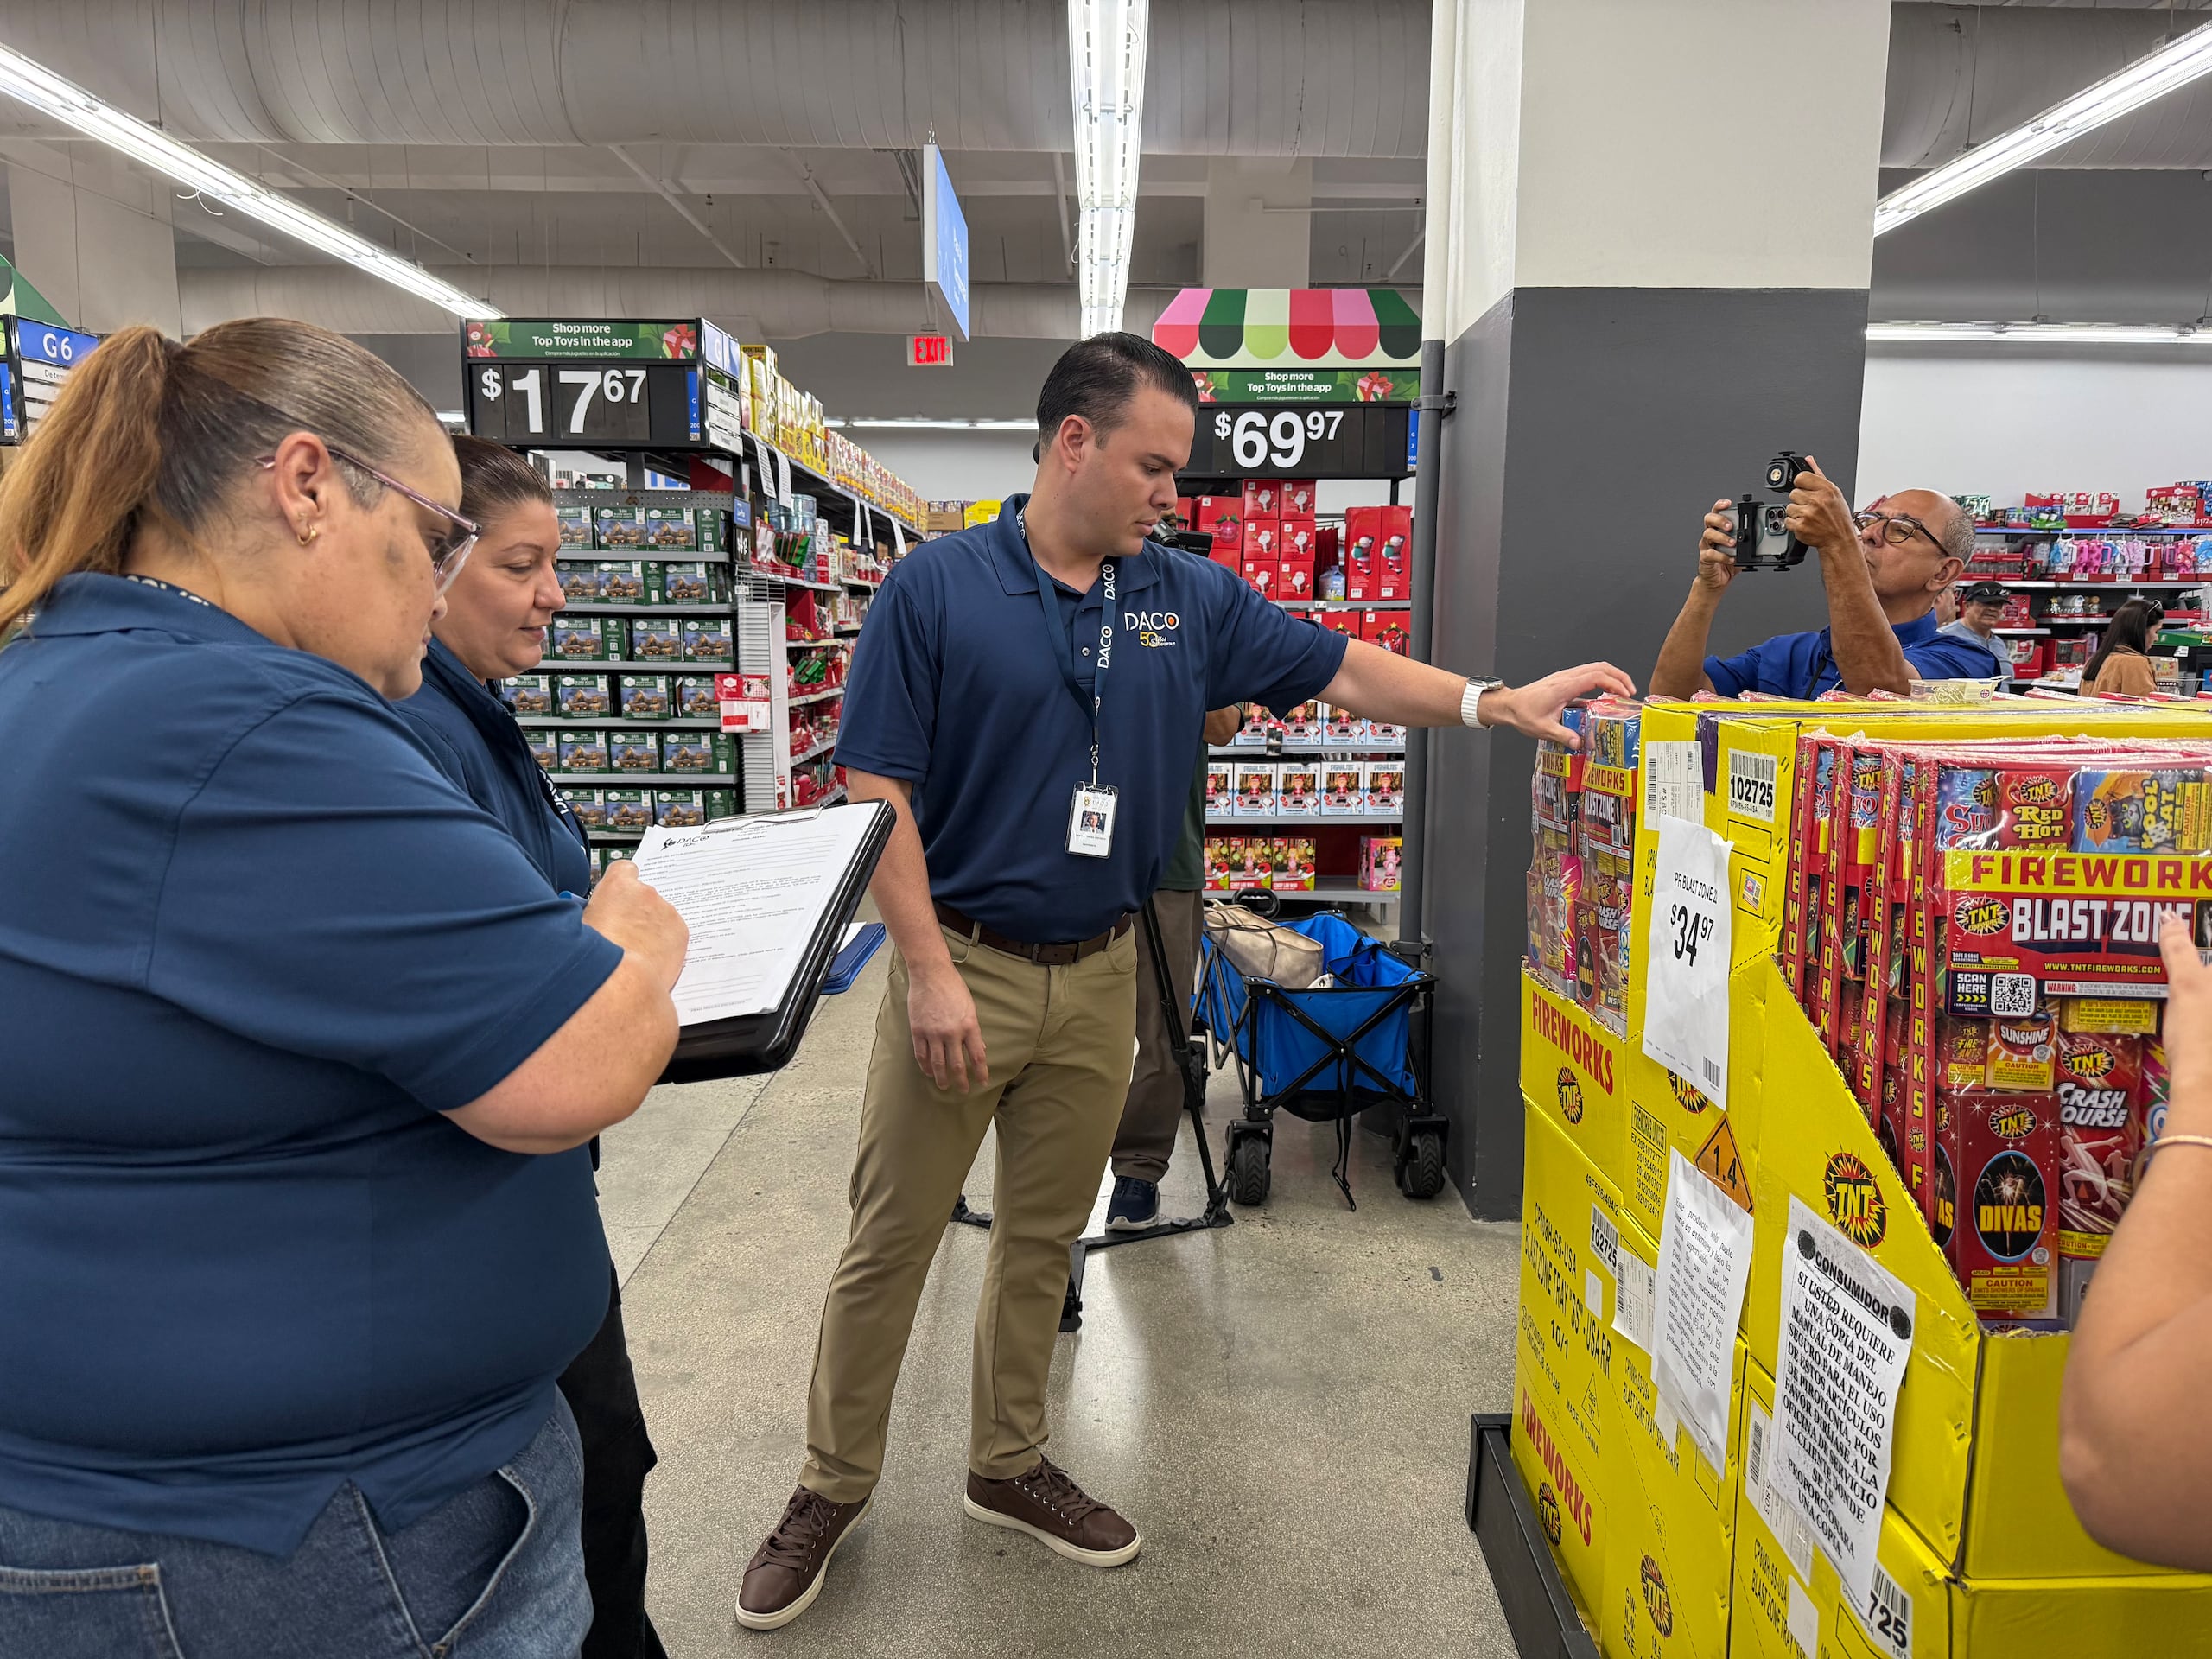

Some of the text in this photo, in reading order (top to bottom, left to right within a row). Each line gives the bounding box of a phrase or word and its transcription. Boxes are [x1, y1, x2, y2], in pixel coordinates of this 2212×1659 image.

[532, 335, 632, 348] Top Toys in the app
[553, 323, 611, 336] Shop more
[914, 337, 947, 364] EXIT
[1247, 383, 1332, 393] Top Toys the app
[1265, 372, 1288, 382] Shop
[1102, 563, 1115, 601] DACO
[1124, 611, 1180, 632] DACO
[1097, 626, 1113, 669] DACO
[1731, 776, 1773, 809] 102725
[2029, 785, 2050, 799] TNT
[2012, 807, 2063, 824] RED
[2012, 824, 2063, 839] HOT
[2183, 795, 2192, 836] CAUTION
[1675, 872, 1713, 901] PR BLAST ZONE
[1968, 904, 1999, 925] TNT
[2012, 898, 2107, 942] BLAST
[1579, 965, 1595, 986] DIVAS
[1912, 803, 1926, 1119] FIREWORKS
[1957, 973, 1986, 983] SCAN
[2044, 963, 2161, 974] WWW.TNTFIREWORKS.COM
[1957, 983, 1986, 994] HERE
[1533, 991, 1614, 1096] FIREWORKS
[2000, 1024, 2050, 1045] SUNSHINE
[2072, 1053, 2103, 1071] TNT
[1561, 1084, 1578, 1110] TNT
[2057, 1082, 2126, 1109] CRASH
[1999, 1112, 2028, 1134] TNT
[1713, 1145, 1737, 1190] 1.4
[1836, 1182, 1872, 1220] TNT
[1980, 1205, 2042, 1232] DIVAS
[1592, 1223, 1618, 1268] 102725
[1675, 1197, 1685, 1211] Este
[1687, 1211, 1708, 1232] producto
[1719, 1242, 1733, 1259] puede
[1692, 1230, 1711, 1252] exteriores
[1713, 1250, 1725, 1267] bajo
[1554, 1267, 1568, 1317] TRAY
[1707, 1273, 1727, 1299] indebido
[1712, 1265, 1719, 1275] de
[1722, 1274, 1730, 1285] un
[1815, 1250, 1889, 1324] CONSUMIDOR
[1698, 1282, 1726, 1312] quemaduras
[1797, 1271, 1896, 1365] SI USTED REQUIERE
[1804, 1298, 1877, 1375] UNA COPIA DEL
[1551, 1319, 1568, 1360] 10/1
[1791, 1305, 1887, 1407] MANUAL DE MANEJO
[1788, 1340, 1882, 1449] DE ESTOS ARTÍCULOS
[1789, 1323, 1885, 1429] SEGURO PARA EL USO
[1566, 1397, 1599, 1455] MADE IN CHINA
[1785, 1376, 1813, 1417] FAVOR
[1851, 1457, 1859, 1474] A
[1860, 1465, 1879, 1492] LA
[1787, 1361, 1799, 1382] DE
[1854, 1436, 1879, 1470] POR
[1522, 1386, 1592, 1548] FIREWORKS
[1783, 1394, 1877, 1510] OFICINA DE SERVICIO
[1785, 1418, 1866, 1524] AL CLIENTE DONDE
[1812, 1467, 1834, 1506] SE LE
[1543, 1501, 1557, 1529] TNT
[1788, 1453, 1855, 1560] PROPORCIONARA
[1798, 1489, 1815, 1522] UNA
[1646, 1577, 1668, 1614] TNT
[1751, 1569, 1793, 1655] BLAST ZONE TRAY
